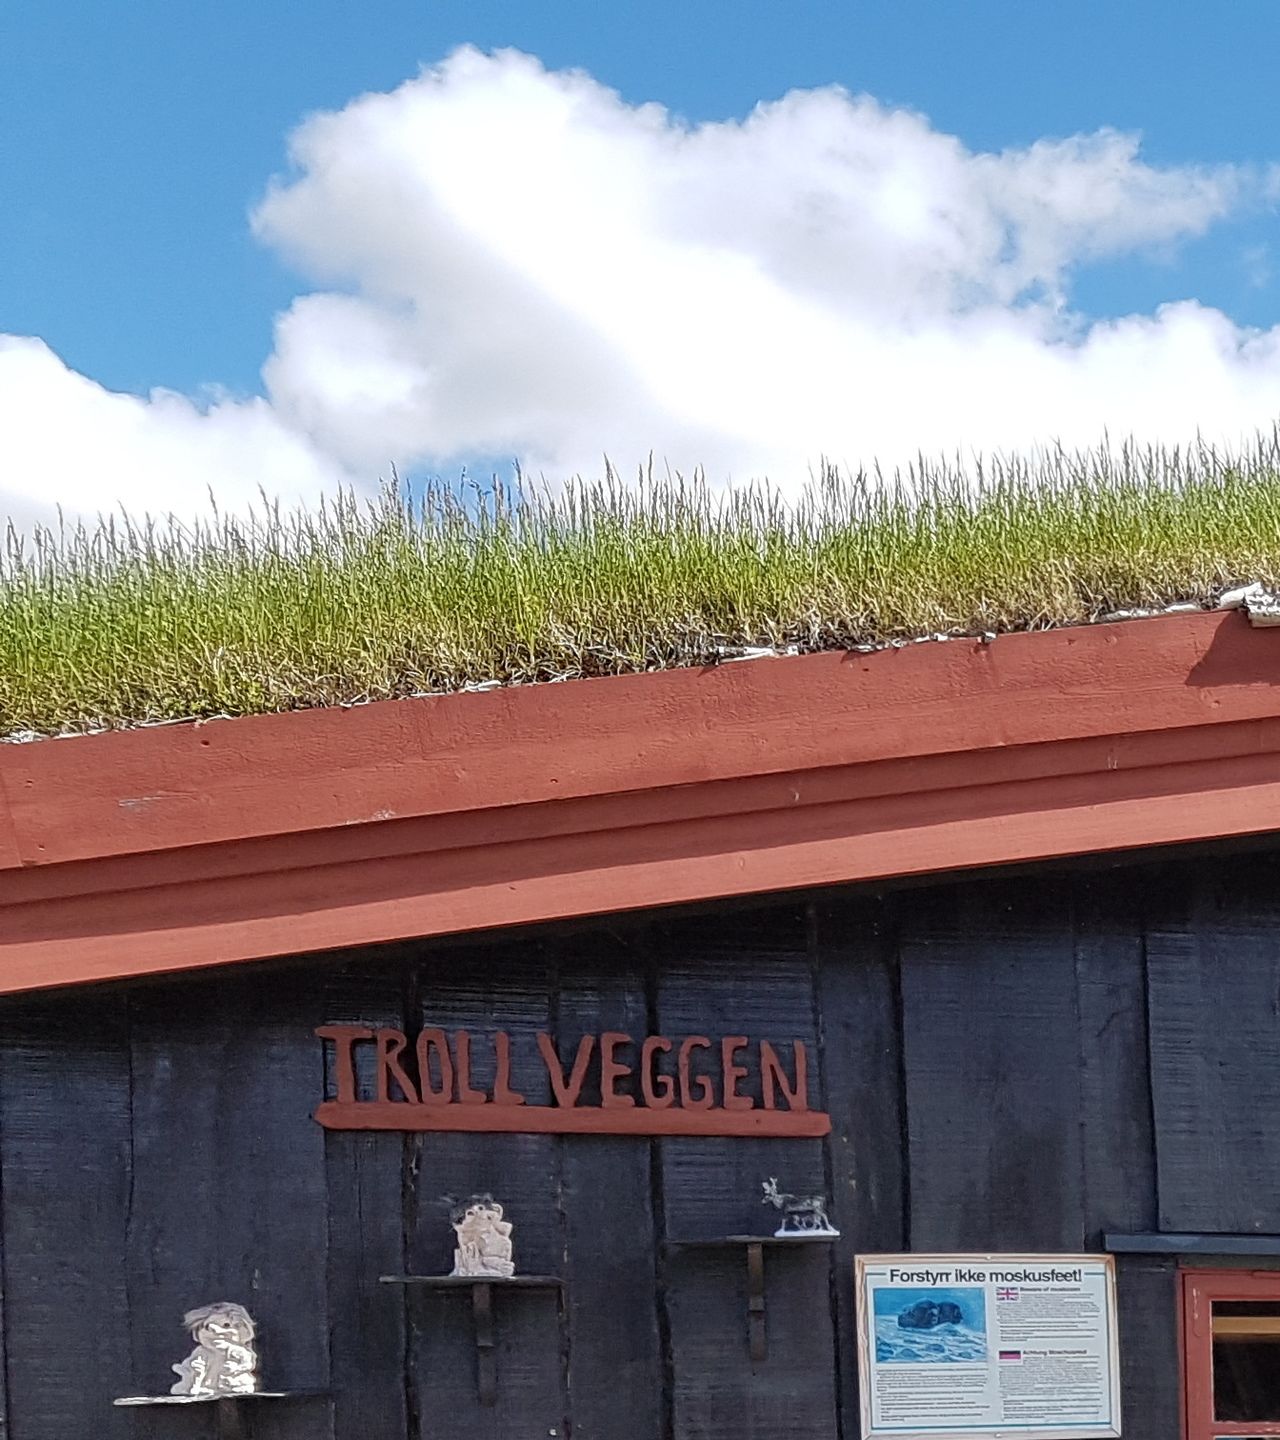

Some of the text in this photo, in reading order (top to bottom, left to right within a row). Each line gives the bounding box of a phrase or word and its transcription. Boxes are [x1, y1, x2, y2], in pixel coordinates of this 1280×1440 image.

[889, 1268, 1082, 1286] Forstyrr ikke moskusfeet!
